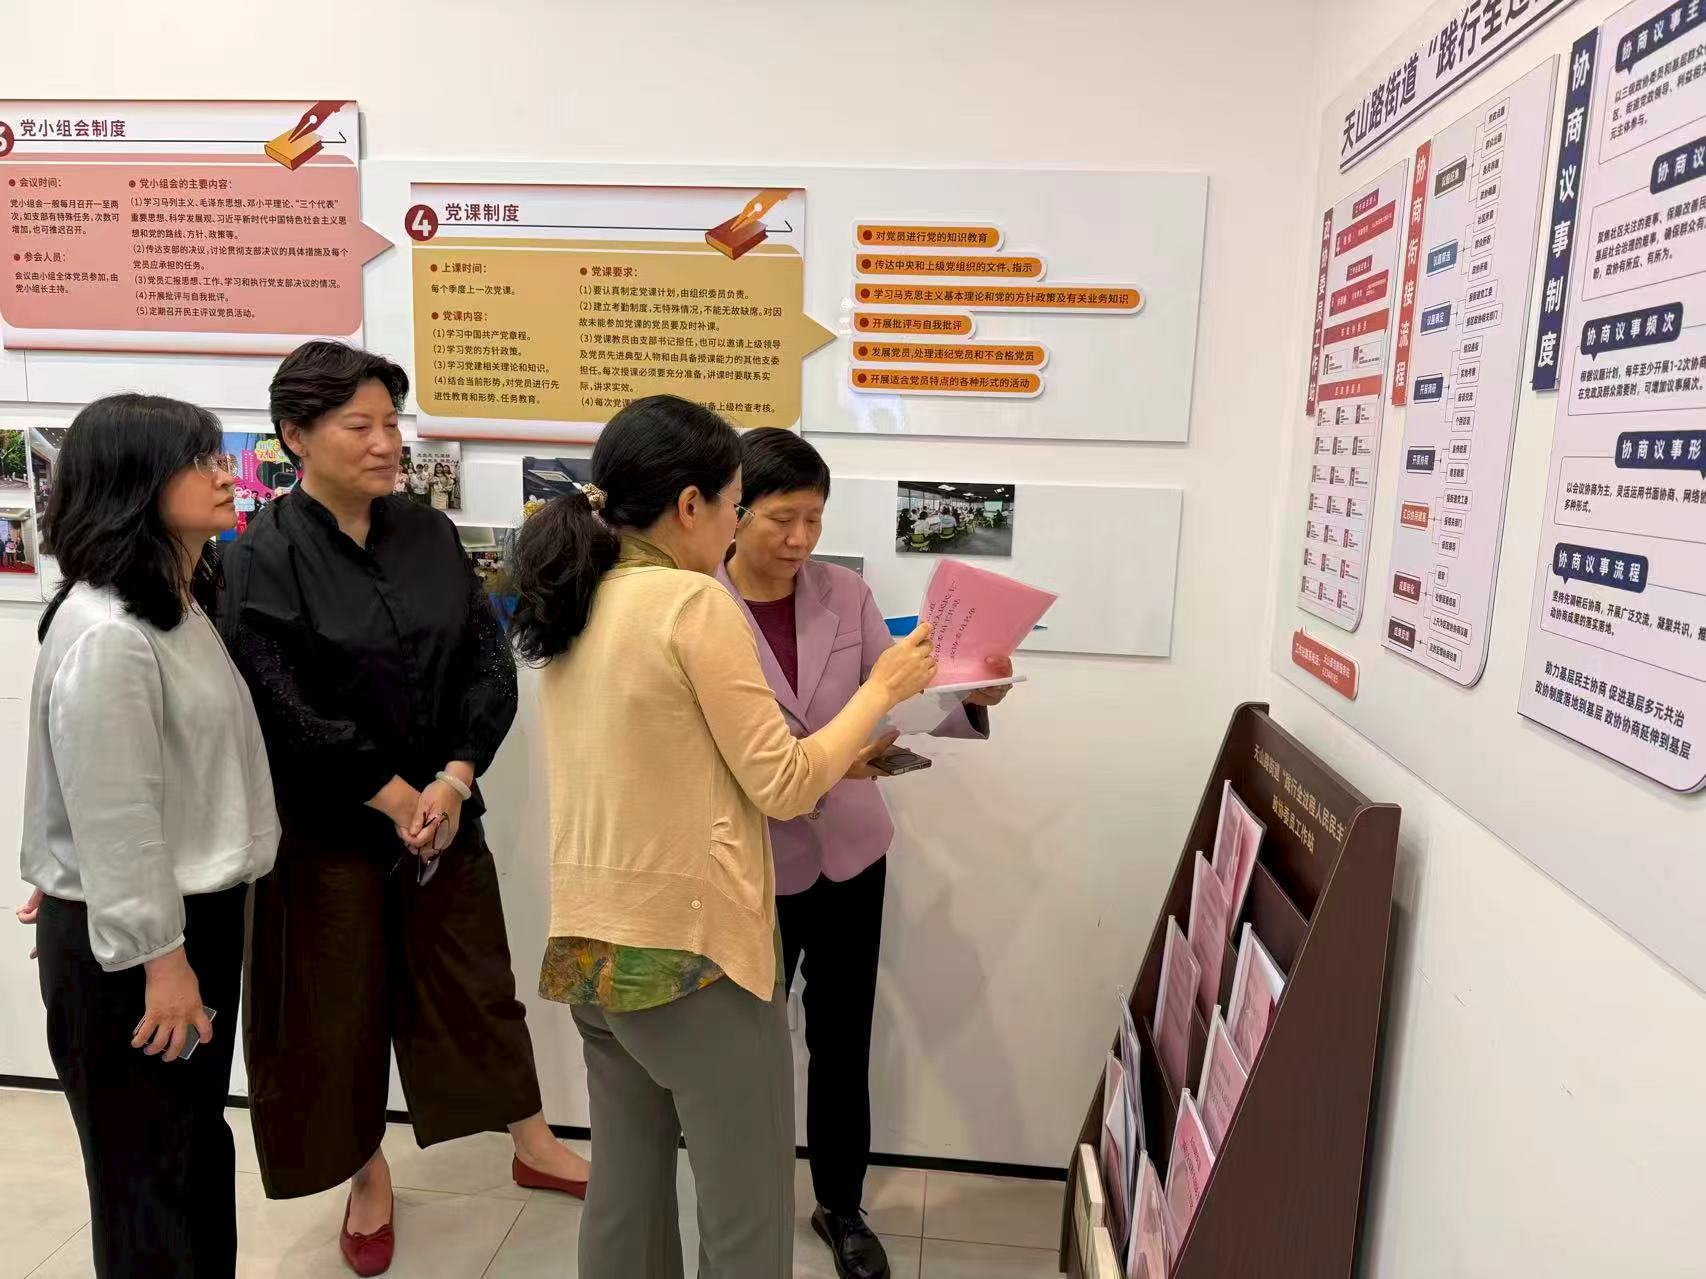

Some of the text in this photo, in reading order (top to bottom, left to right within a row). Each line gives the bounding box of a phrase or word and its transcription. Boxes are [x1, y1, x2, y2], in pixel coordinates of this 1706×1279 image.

[1621, 0, 1700, 62] 协商议事主
[1341, 53, 1419, 156] 天山路街道
[20, 119, 126, 137] 党小组会制度
[1657, 146, 1706, 183] 协商议
[20, 177, 62, 188] 会议时间：
[139, 178, 232, 190] 党小组会的主要内容：
[10, 199, 119, 209] 党小组会一般每月召开一至两
[1537, 49, 1591, 367] 协商议事制度
[131, 213, 347, 225] 重要思想、科学发展观、习近平新时代中国特色社会主义思
[444, 203, 520, 223] 党课制度
[411, 210, 433, 237] 4
[131, 229, 239, 240] 想和党的路线、方针、政策等。
[875, 231, 988, 243] 对党员进行党的知识教育
[24, 251, 66, 262] 参会人员：
[133, 260, 206, 271] 党员应承担的任务。
[441, 262, 487, 274] 上课时间：
[591, 266, 639, 278] 党课要求：
[874, 260, 1033, 273] 传达中央和上级党组织的文件、指示
[15, 284, 69, 294] 党小组长主持。
[431, 284, 515, 295] 每个季度上一次党课。
[135, 291, 229, 302] (4)开展批评与自我批评。
[873, 288, 1129, 304] 学习马克思主义基本理论和党的方针政策及有关业务知识
[442, 311, 488, 321] 党课内容：
[579, 318, 720, 331] 故未能参加党课的党员要及时补课。
[872, 318, 962, 330] 开展批评与自我批评
[1586, 312, 1676, 346] 协商议事频次
[432, 329, 531, 340] (1)学习中国共产党章程。
[433, 345, 521, 356] (2)学习党的方针政策。
[579, 350, 780, 365] 及党员先进典型人物和由具备授课能力的其他支委
[433, 361, 550, 372] (3)学习党建相关理论和知识。
[870, 374, 1030, 389] 开展适合党员特点的各种形式的活动
[434, 391, 540, 404] 进性教育和形势、任务教育。
[1621, 439, 1702, 460] 协商议事形
[1558, 549, 1641, 583] 协商议事流程
[1544, 660, 1685, 729] 助力基层民主协商 促进基层多元共治
[1534, 679, 1692, 760] 政协制度落地到基层 政协协商延伸到基层
[1272, 793, 1315, 854] 政协委员工作站
